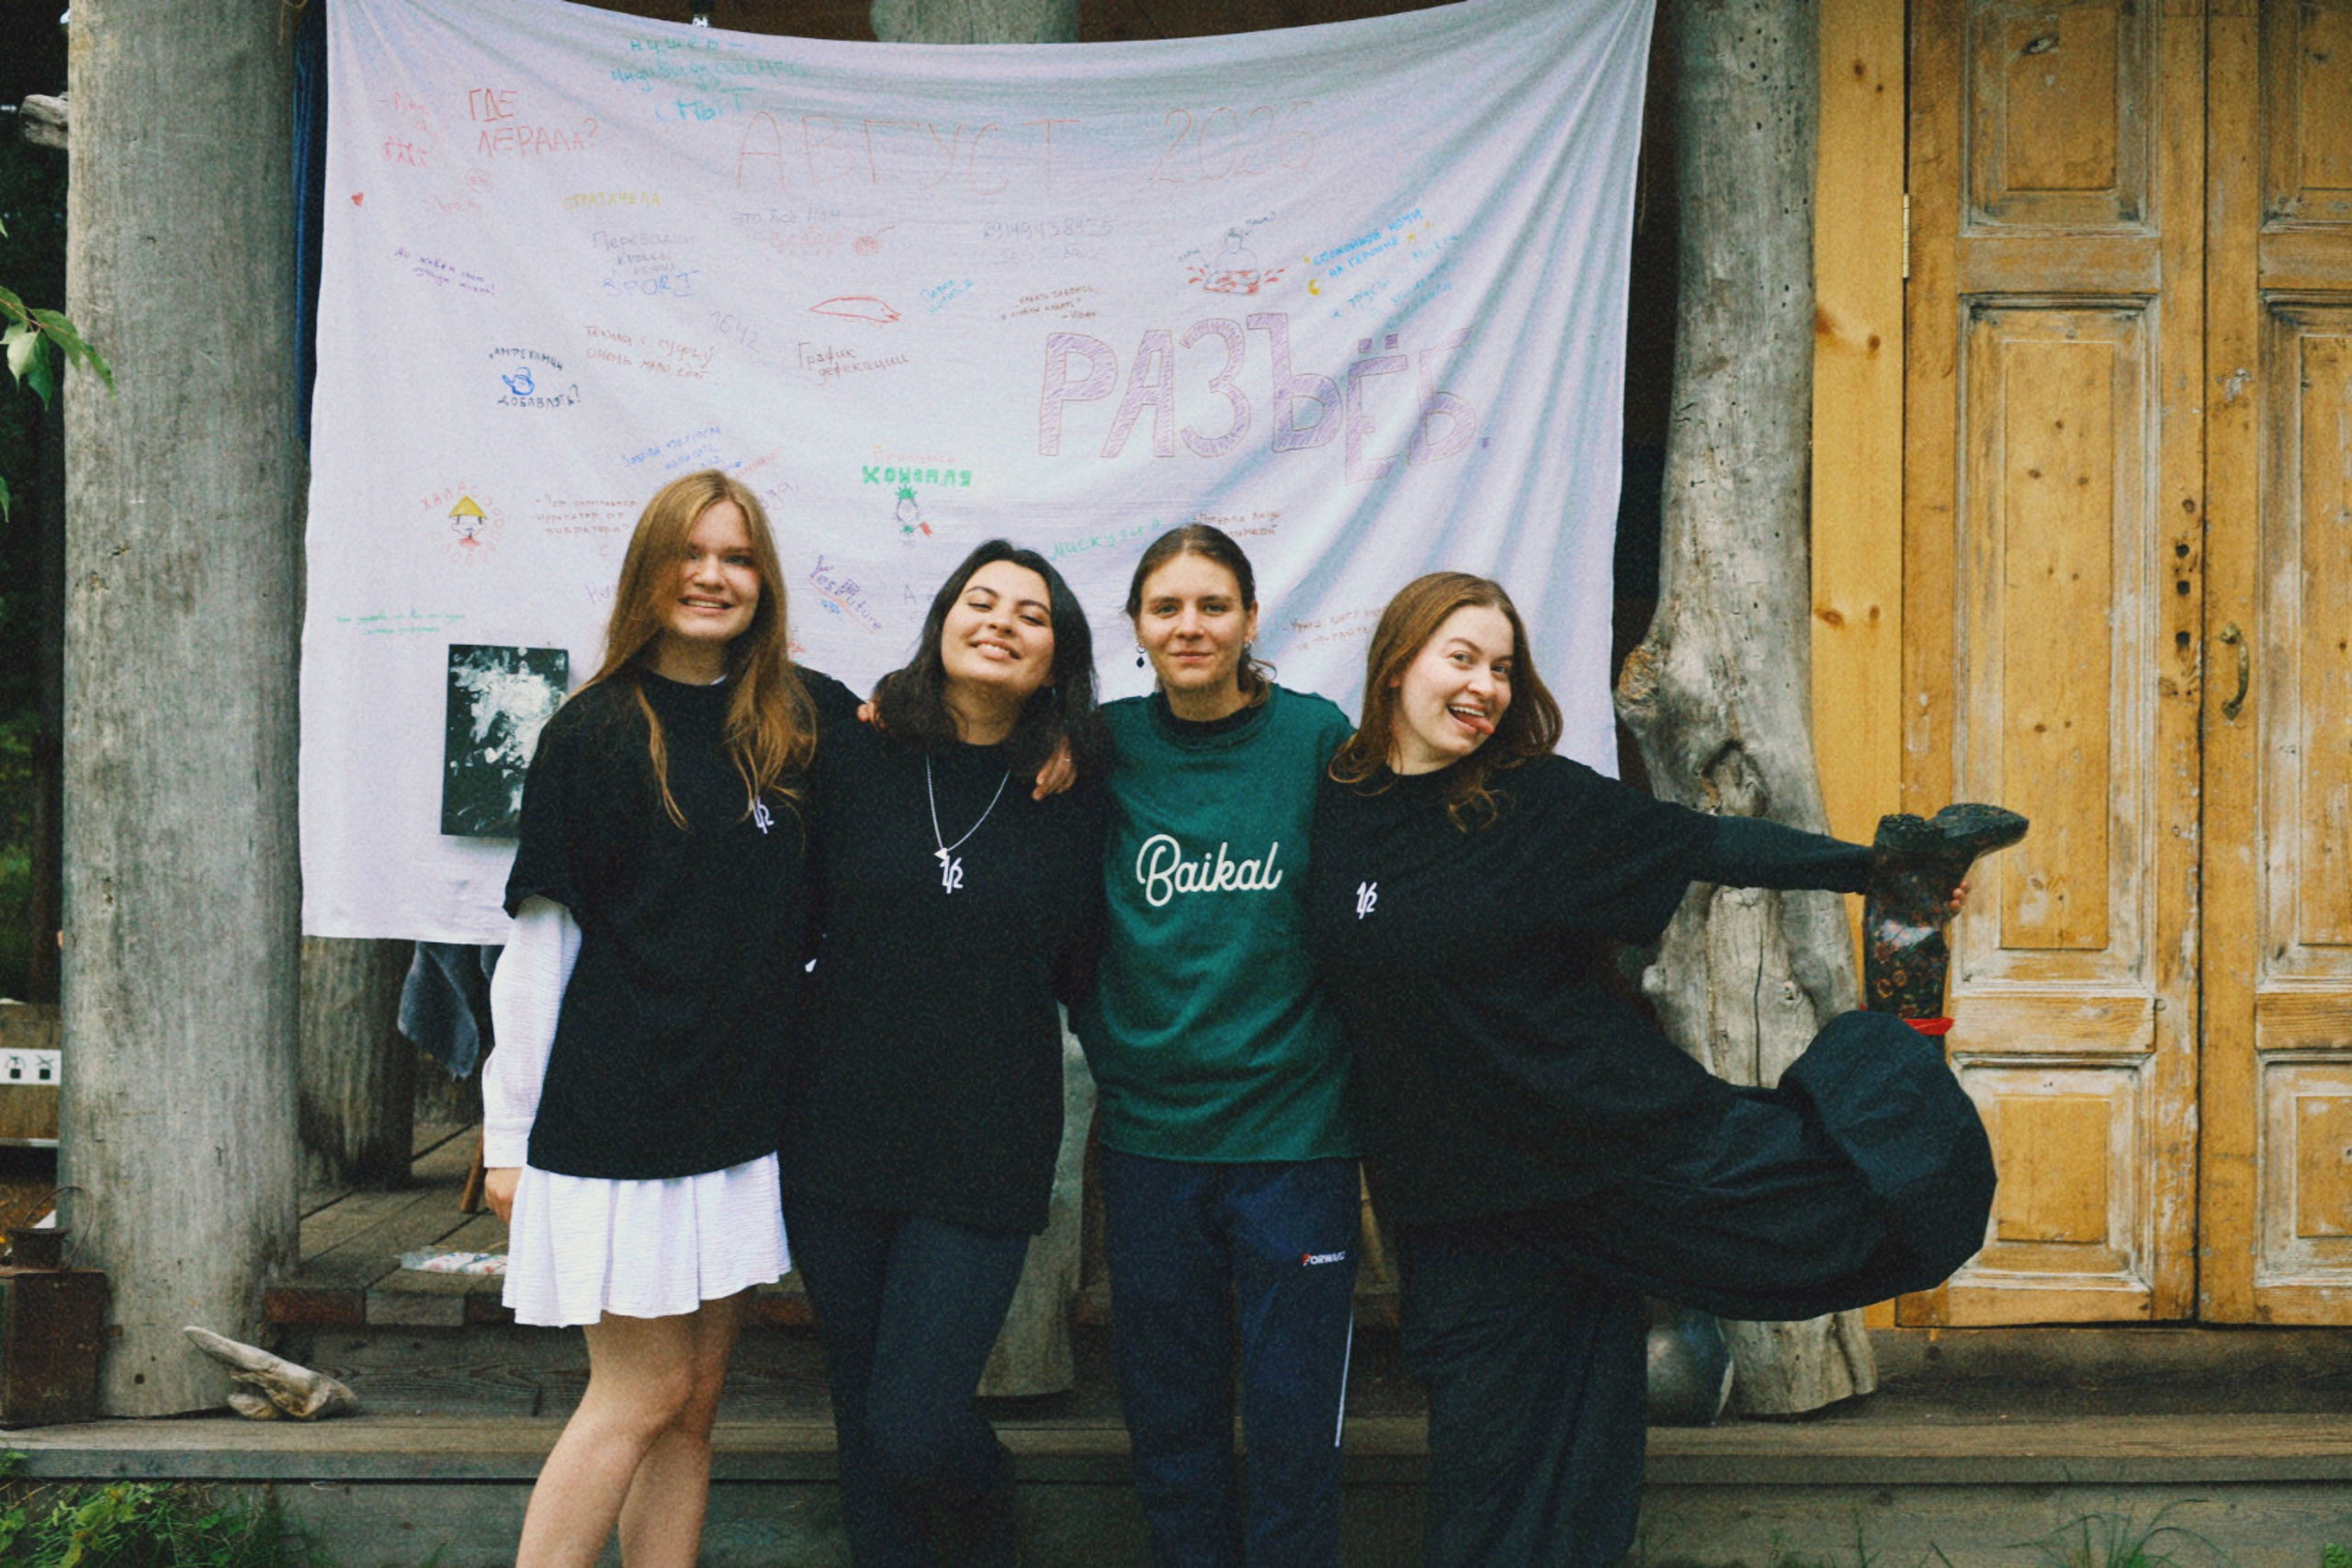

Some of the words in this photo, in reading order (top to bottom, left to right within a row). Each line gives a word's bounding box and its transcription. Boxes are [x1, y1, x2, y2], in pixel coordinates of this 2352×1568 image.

[469, 87, 517, 122] ГДЕ
[736, 109, 1081, 197] АВГУСТ
[797, 341, 857, 372] График
[1136, 834, 1283, 908] Baikal
